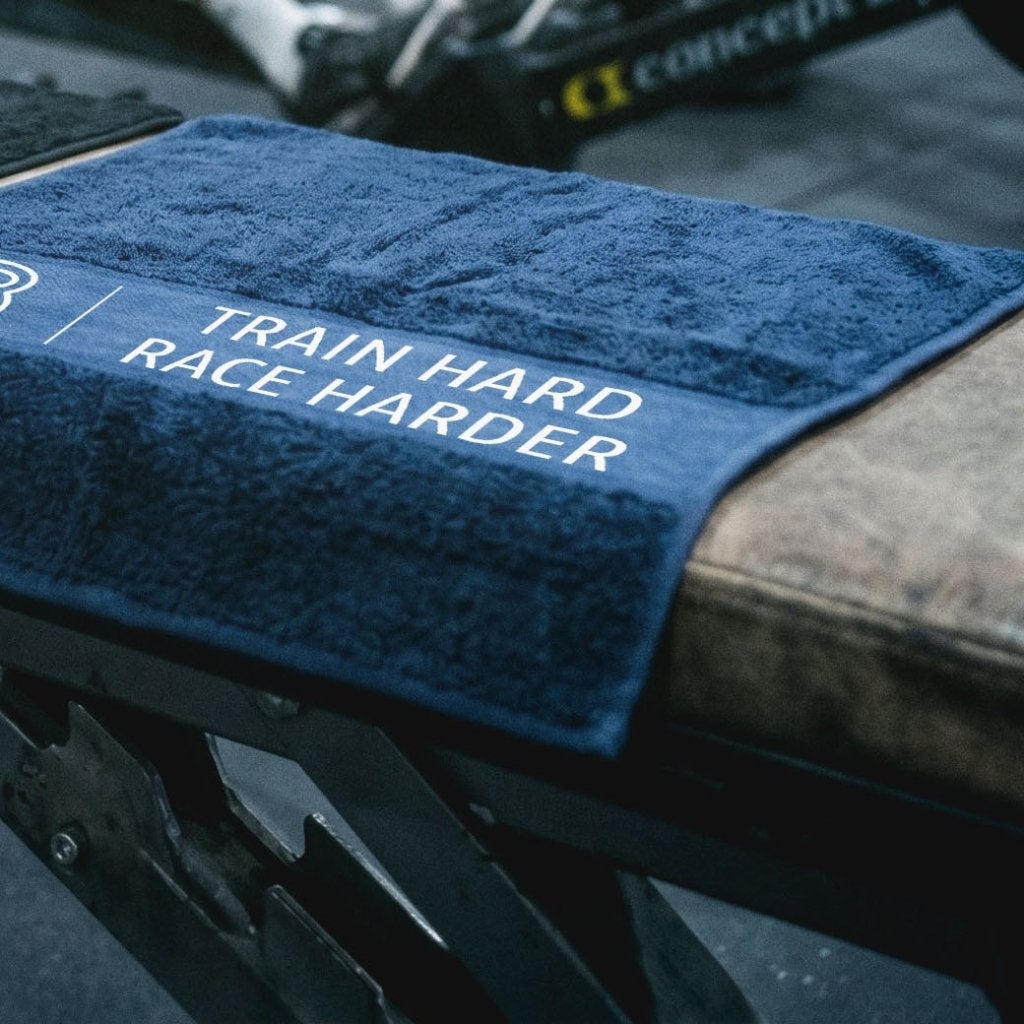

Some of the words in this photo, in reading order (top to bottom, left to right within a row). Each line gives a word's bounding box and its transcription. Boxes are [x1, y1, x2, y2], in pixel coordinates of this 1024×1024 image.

[119, 337, 306, 398] RACE
[305, 378, 628, 472] HARDER
[200, 305, 414, 373] TRAIN
[416, 353, 643, 420] HARD
